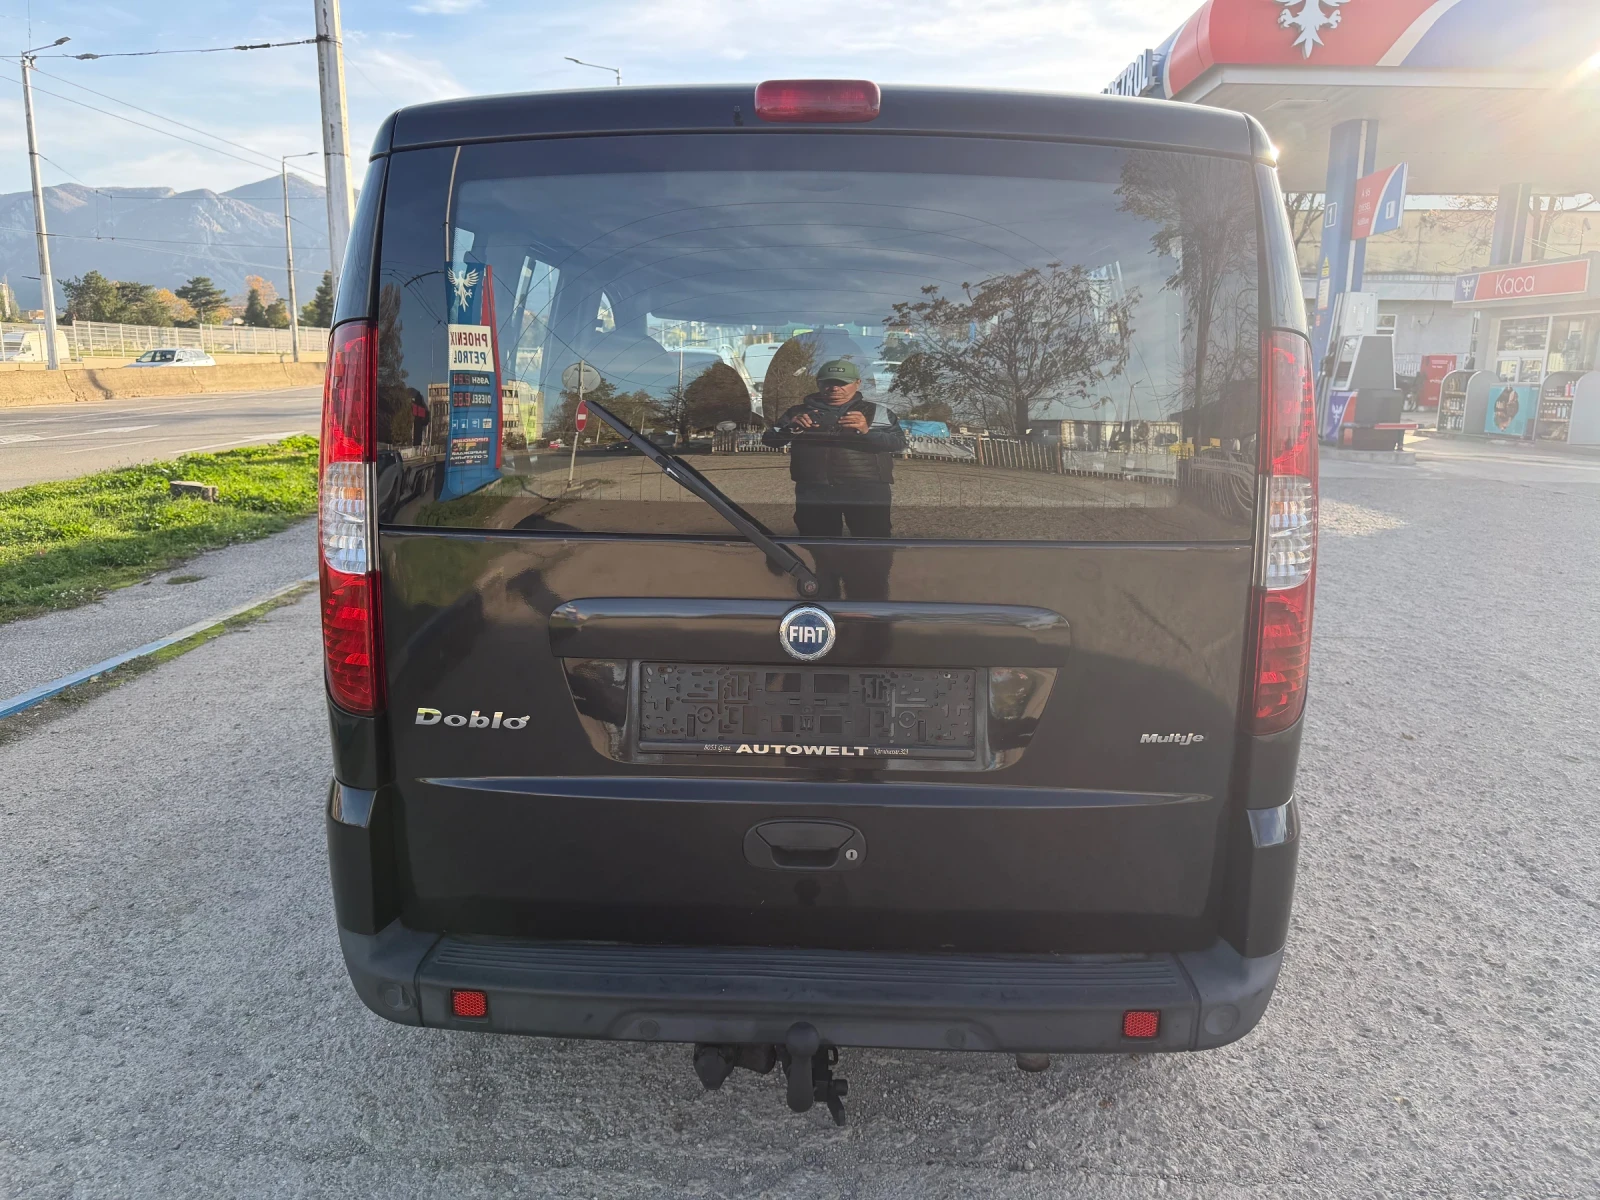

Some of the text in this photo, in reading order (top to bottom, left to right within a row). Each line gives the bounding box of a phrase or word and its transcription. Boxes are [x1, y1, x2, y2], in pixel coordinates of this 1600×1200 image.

[1494, 273, 1536, 296] Каса
[789, 625, 826, 644] FIAT
[735, 743, 869, 757] AUTOWELT
